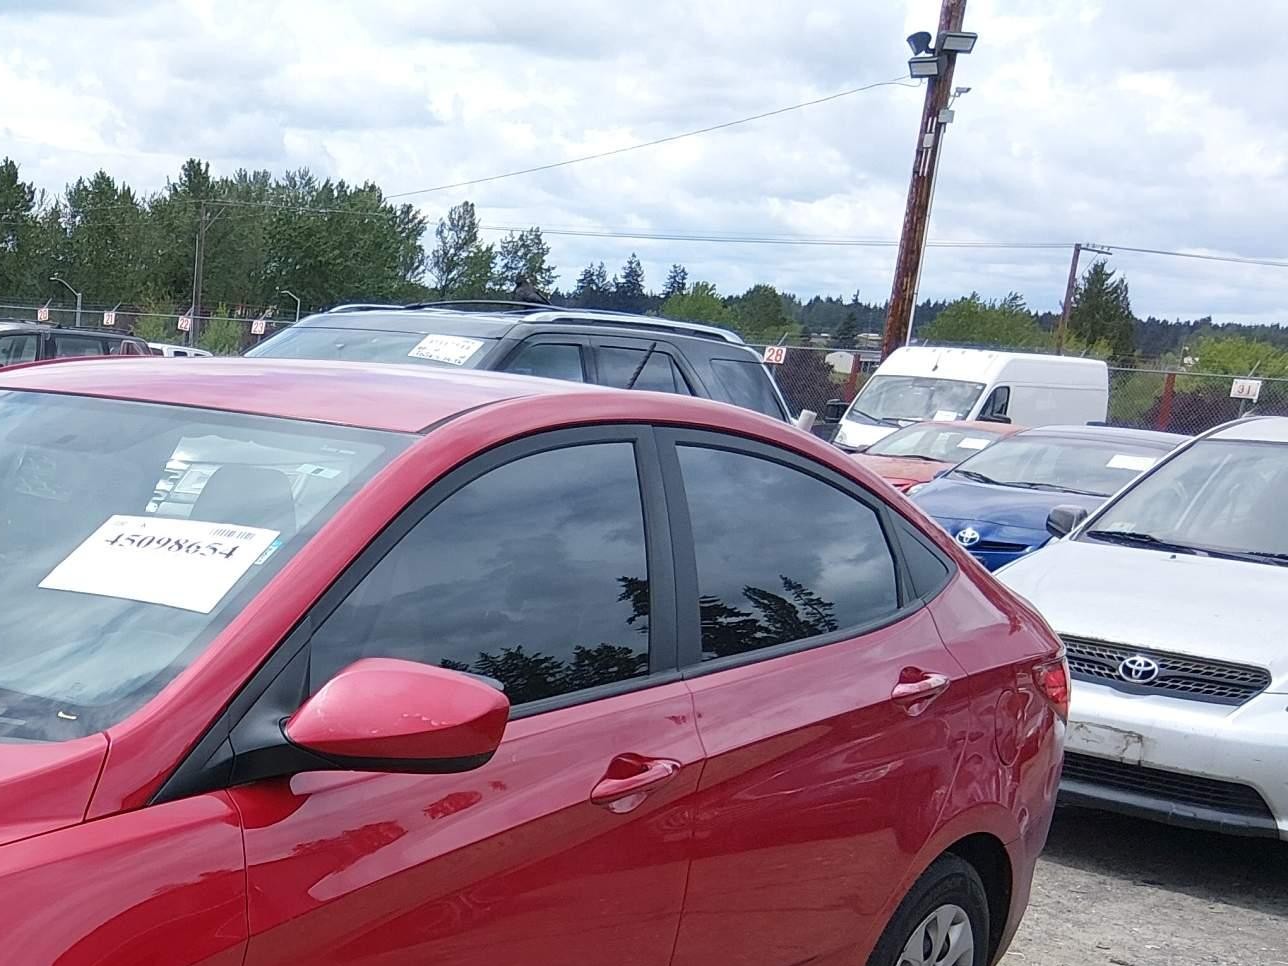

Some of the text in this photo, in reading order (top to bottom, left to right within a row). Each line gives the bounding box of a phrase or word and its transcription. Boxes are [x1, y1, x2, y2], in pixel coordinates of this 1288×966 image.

[38, 309, 47, 320] 20
[106, 313, 113, 323] 21
[179, 318, 189, 330] 22
[252, 323, 263, 333] 23
[766, 347, 784, 363] 28
[1237, 385, 1250, 396] 31
[105, 532, 240, 559] 45098654
